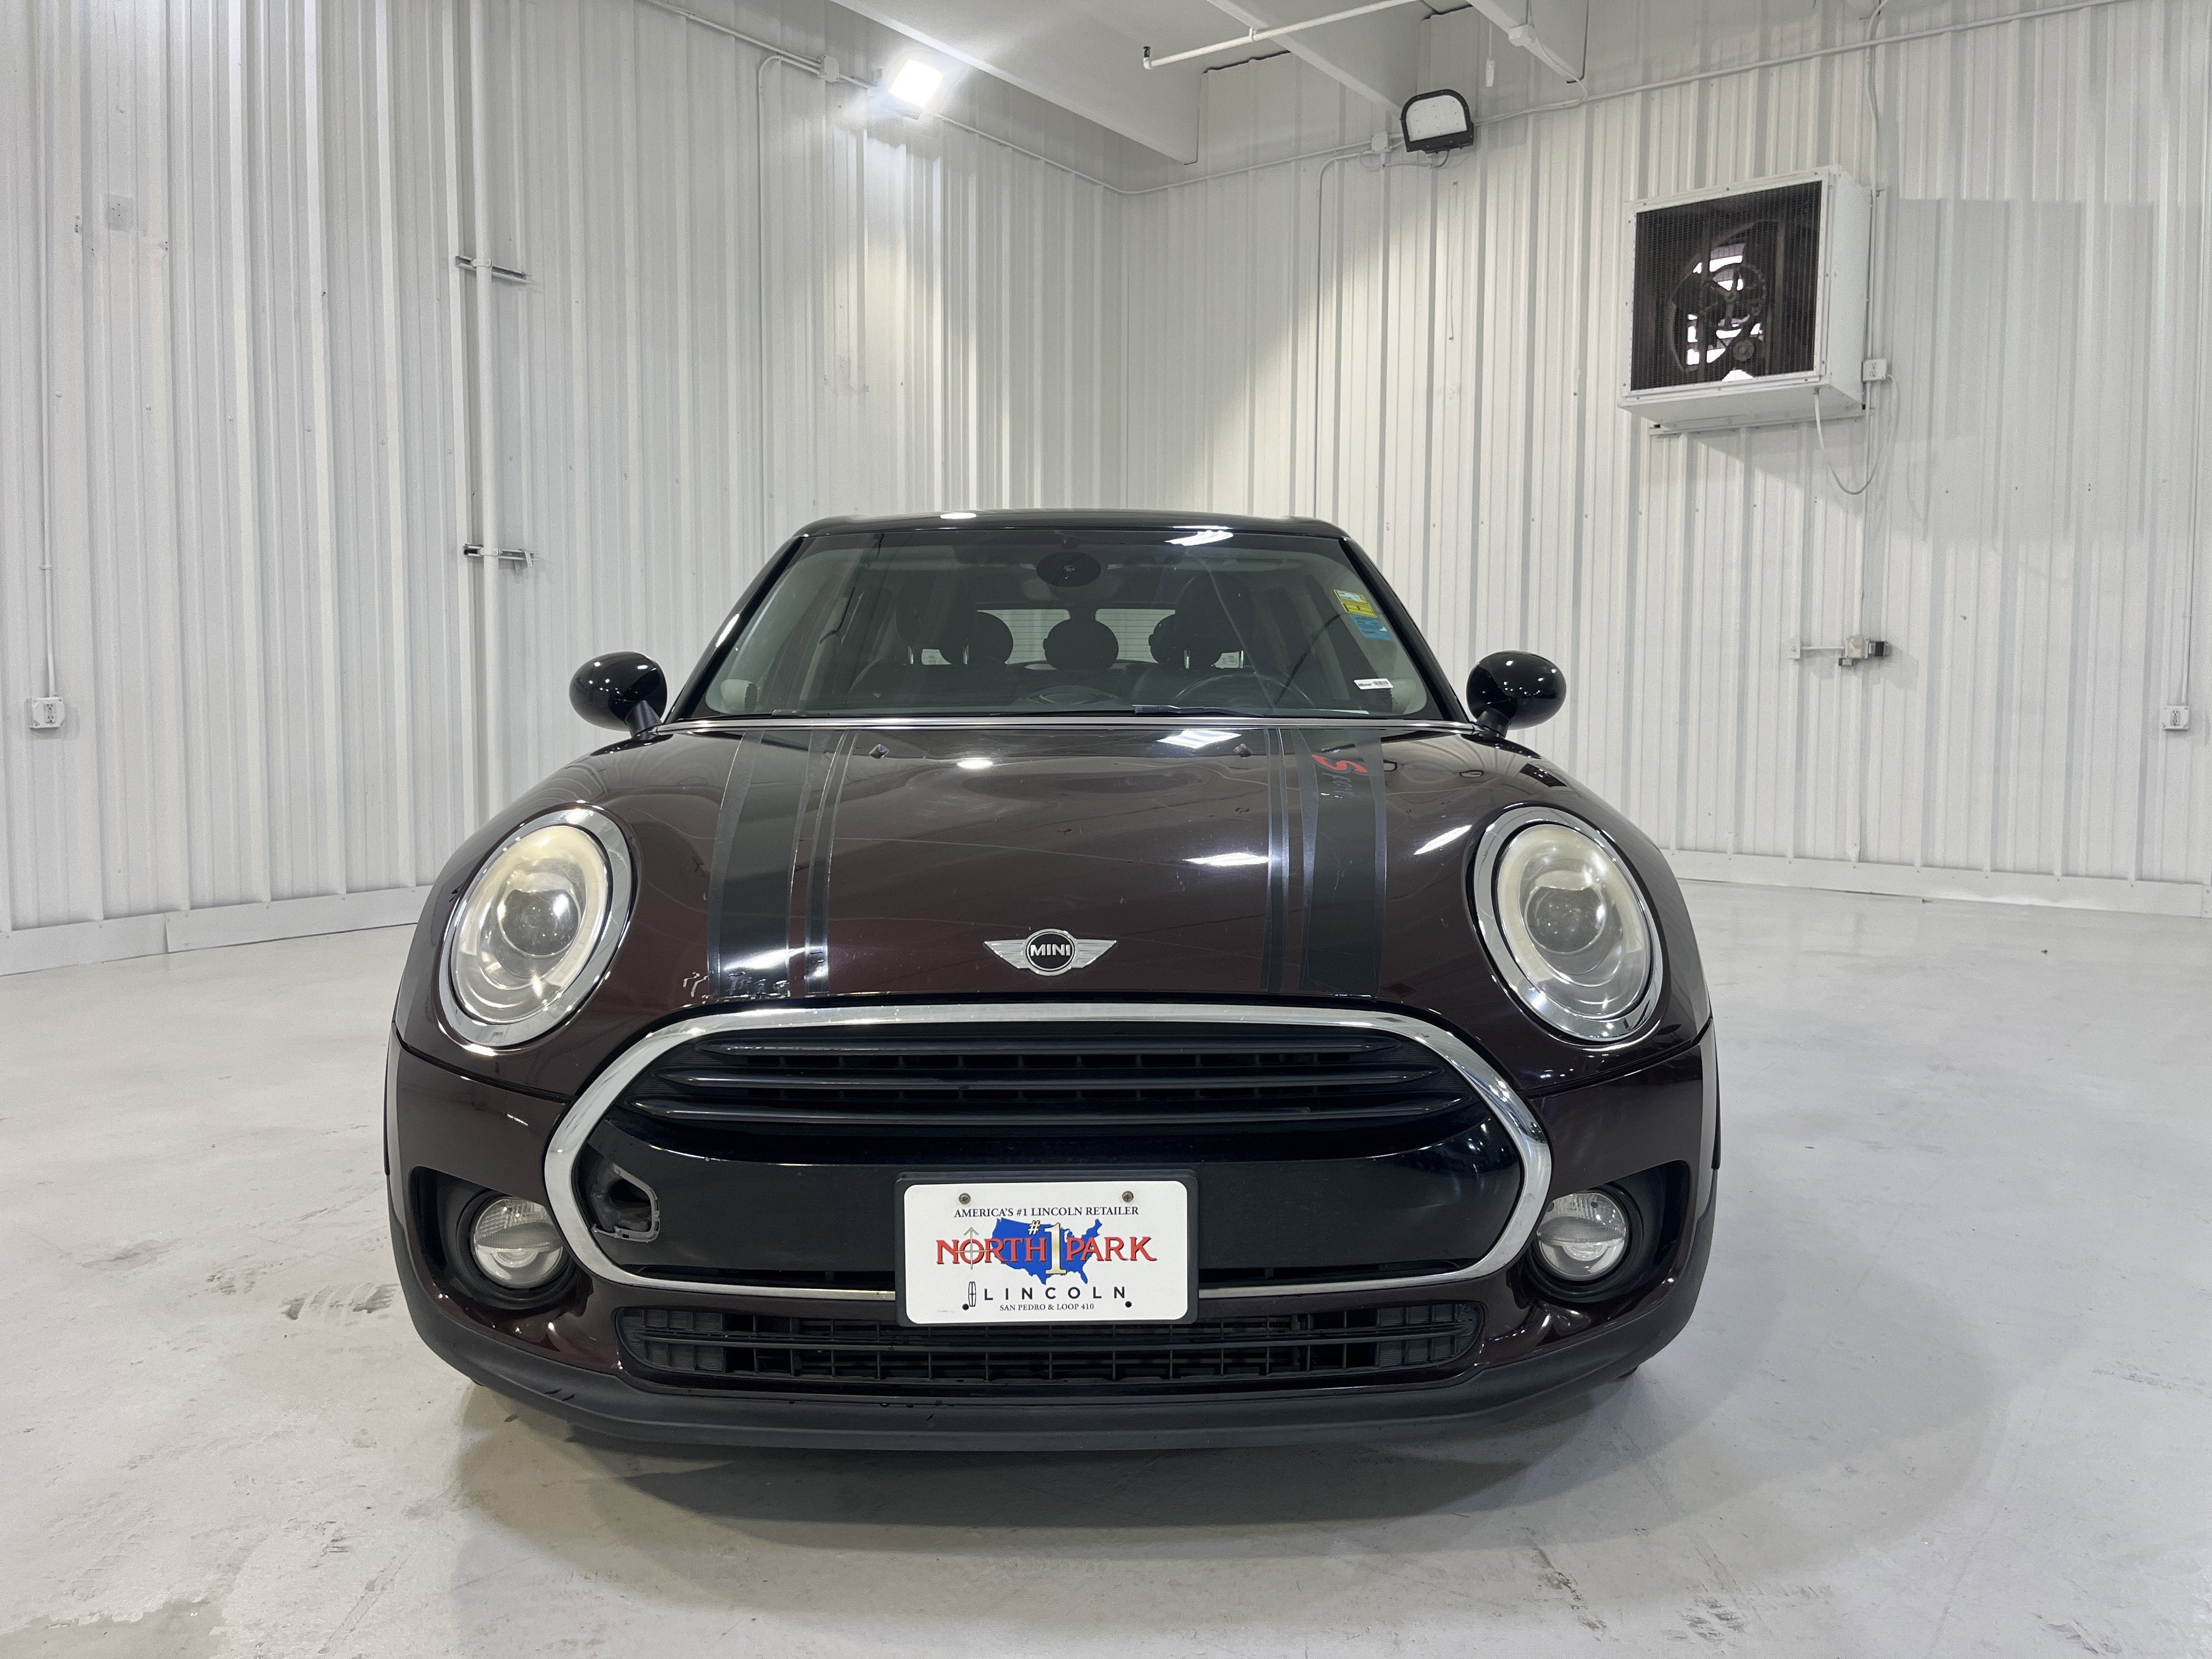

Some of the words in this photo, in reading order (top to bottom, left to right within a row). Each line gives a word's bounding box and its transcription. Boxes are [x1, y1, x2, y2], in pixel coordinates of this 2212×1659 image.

[1030, 944, 1070, 956] MINI
[954, 1207, 1014, 1218] AMERICA'S
[1016, 1208, 1028, 1217] #1
[1031, 1207, 1083, 1216] LINCOLN
[1085, 1206, 1139, 1216] RETAILER
[936, 1236, 1047, 1265] NORTH
[1066, 1236, 1158, 1262] PARK
[984, 1286, 1125, 1300] LINCOLN
